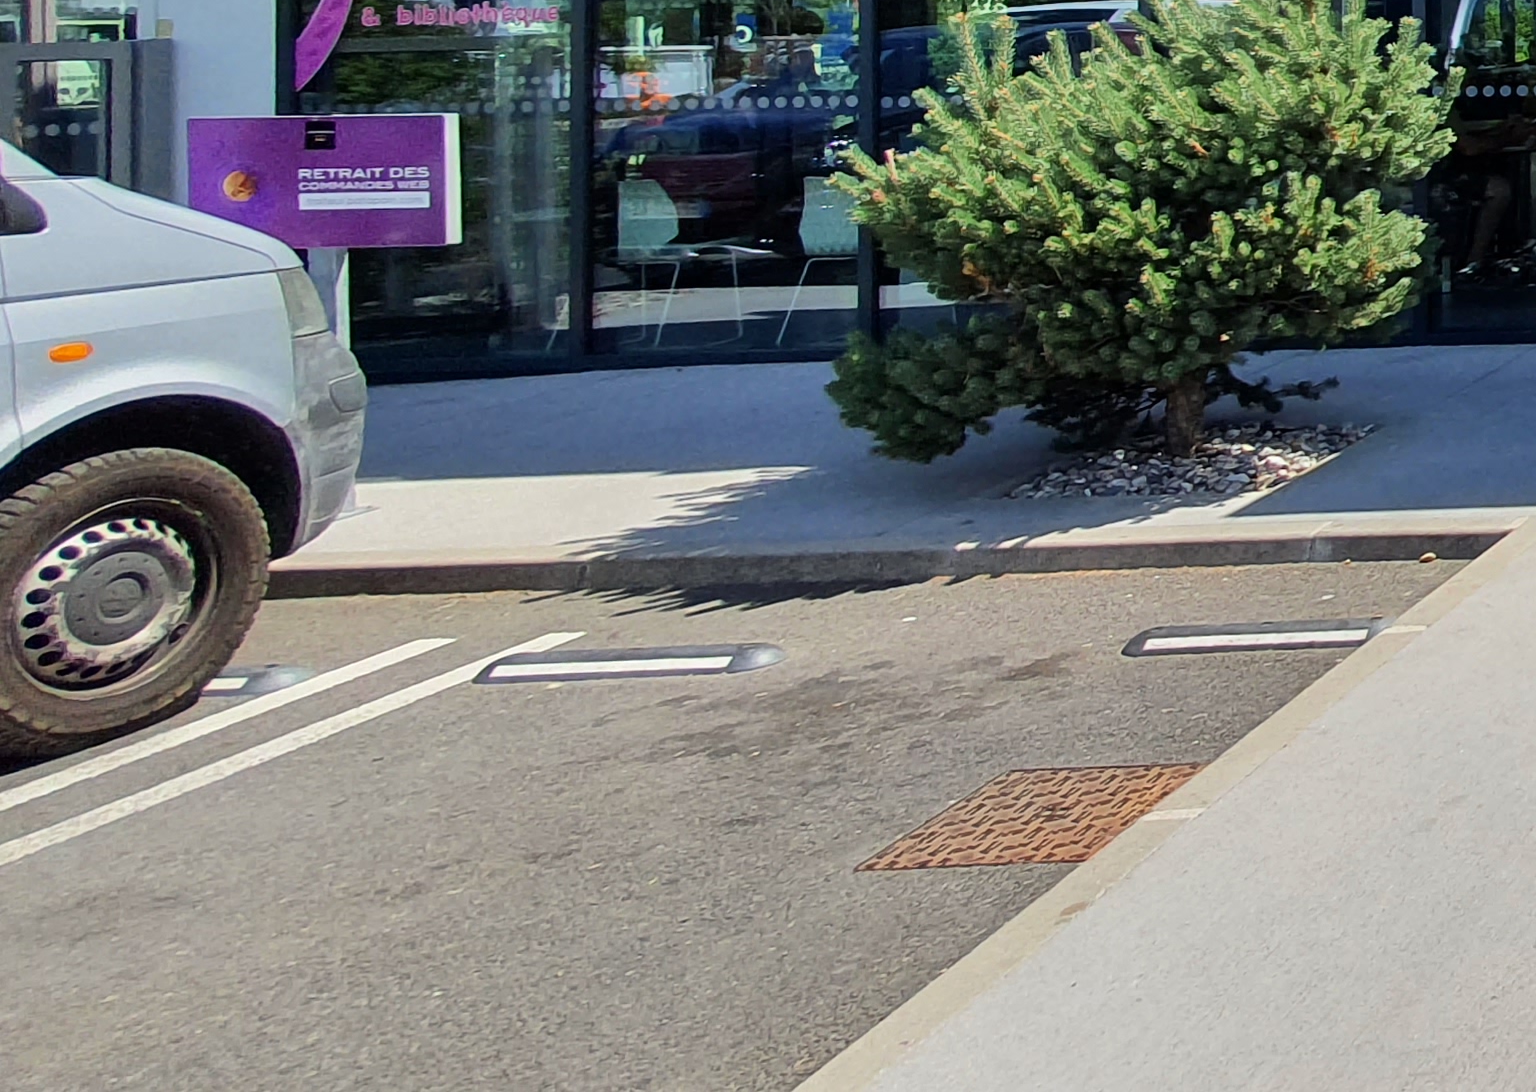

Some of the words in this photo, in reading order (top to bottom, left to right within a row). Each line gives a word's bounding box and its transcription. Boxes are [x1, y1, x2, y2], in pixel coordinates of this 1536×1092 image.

[361, 6, 381, 26] &
[298, 168, 385, 180] RETRAIT
[389, 166, 430, 179] DES
[298, 180, 395, 191] COMMANDES
[397, 179, 430, 190] WEB
